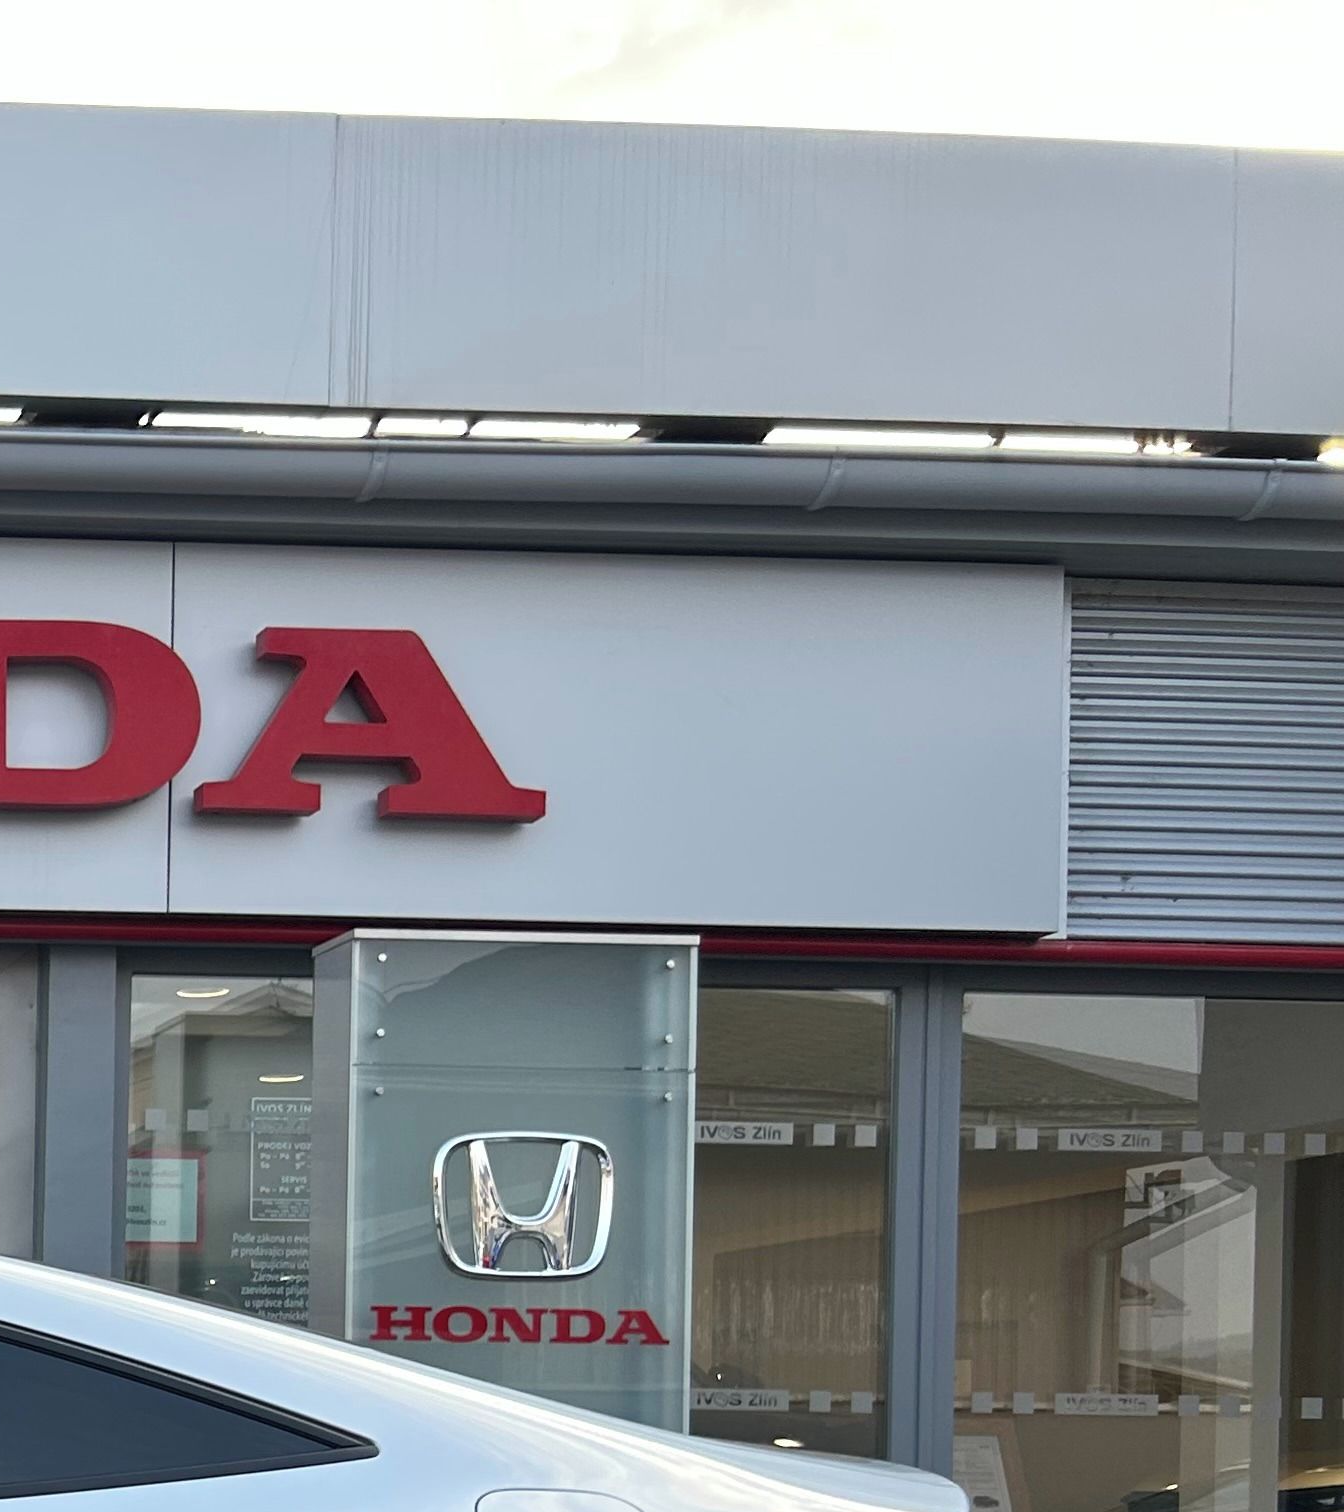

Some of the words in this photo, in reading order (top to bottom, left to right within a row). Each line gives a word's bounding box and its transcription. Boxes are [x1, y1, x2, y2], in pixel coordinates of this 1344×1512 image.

[700, 1125, 746, 1140] IVOS
[752, 1124, 781, 1140] Zlín
[1070, 1132, 1115, 1148] IVOS
[370, 1306, 670, 1346] HONDA
